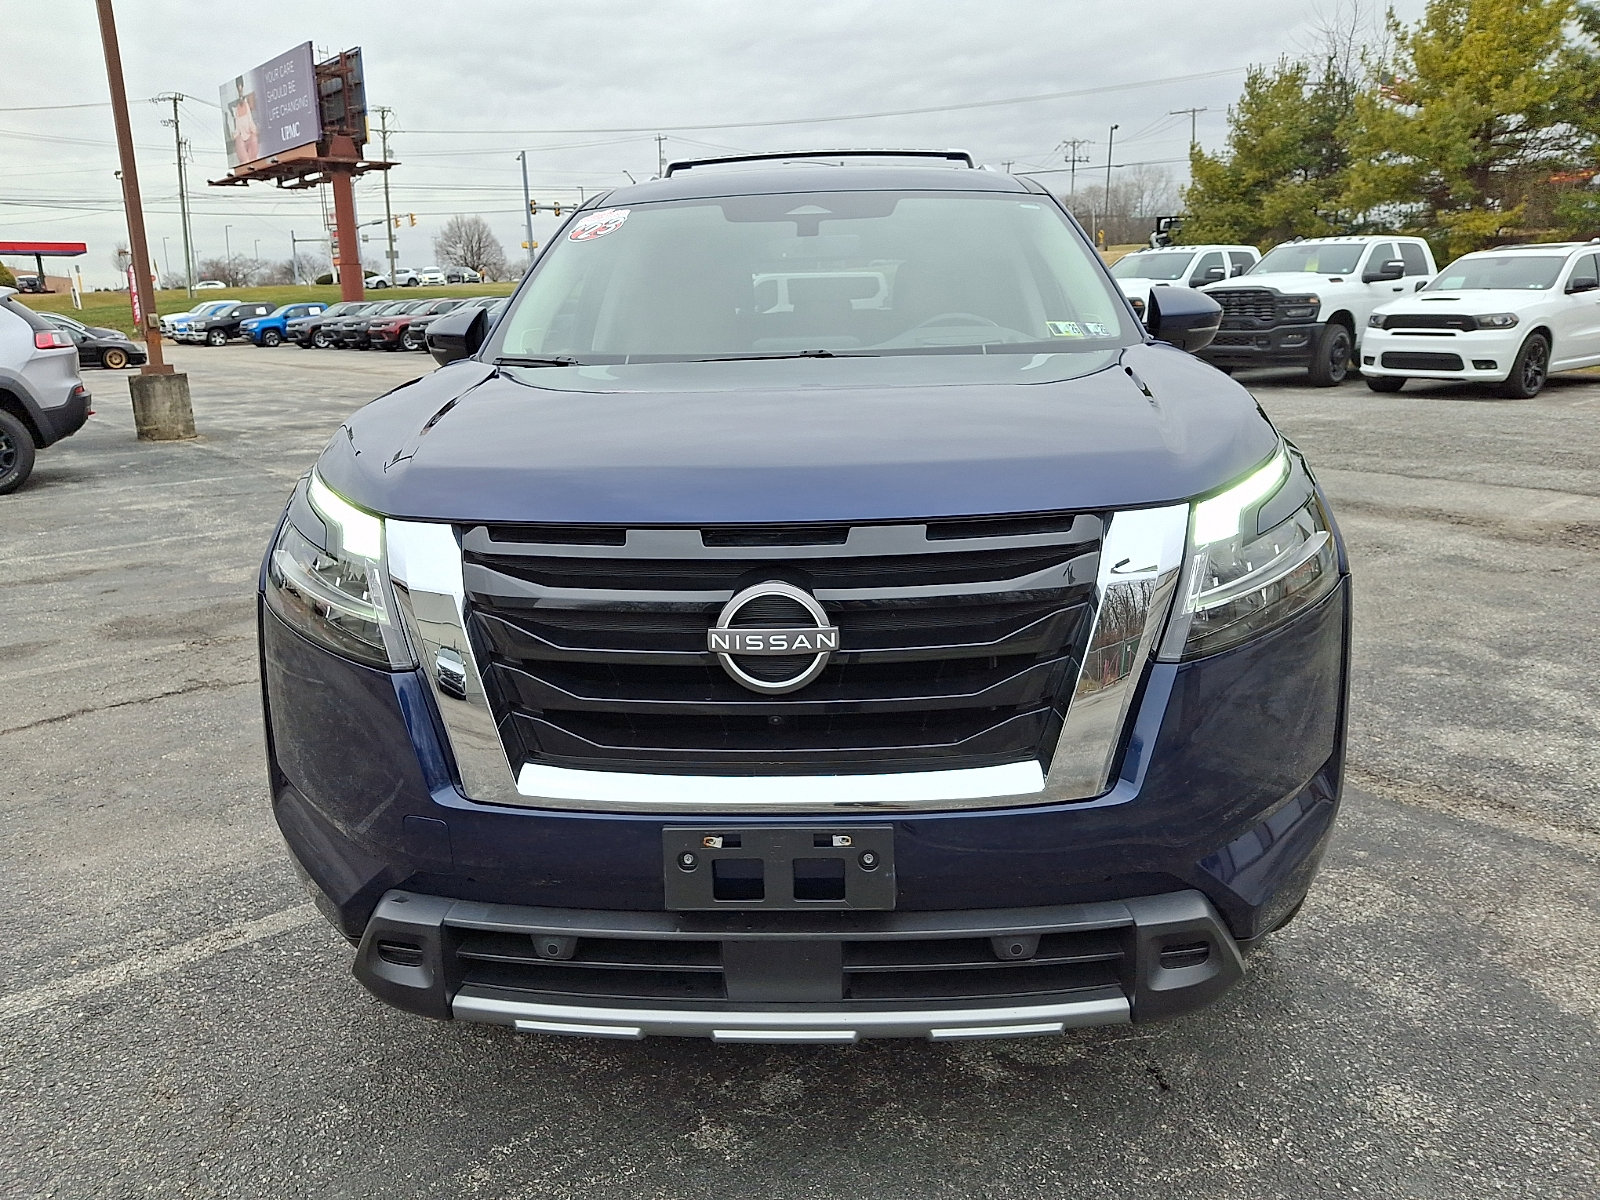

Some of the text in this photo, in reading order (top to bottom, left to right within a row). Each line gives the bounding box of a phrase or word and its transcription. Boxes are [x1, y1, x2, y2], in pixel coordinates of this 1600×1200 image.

[265, 60, 295, 83] YOUR CARE
[266, 80, 296, 102] SHOULD BE
[269, 94, 309, 121] LIFE CHANGING
[281, 121, 301, 141] UPMC
[711, 632, 836, 650] NISSAN
